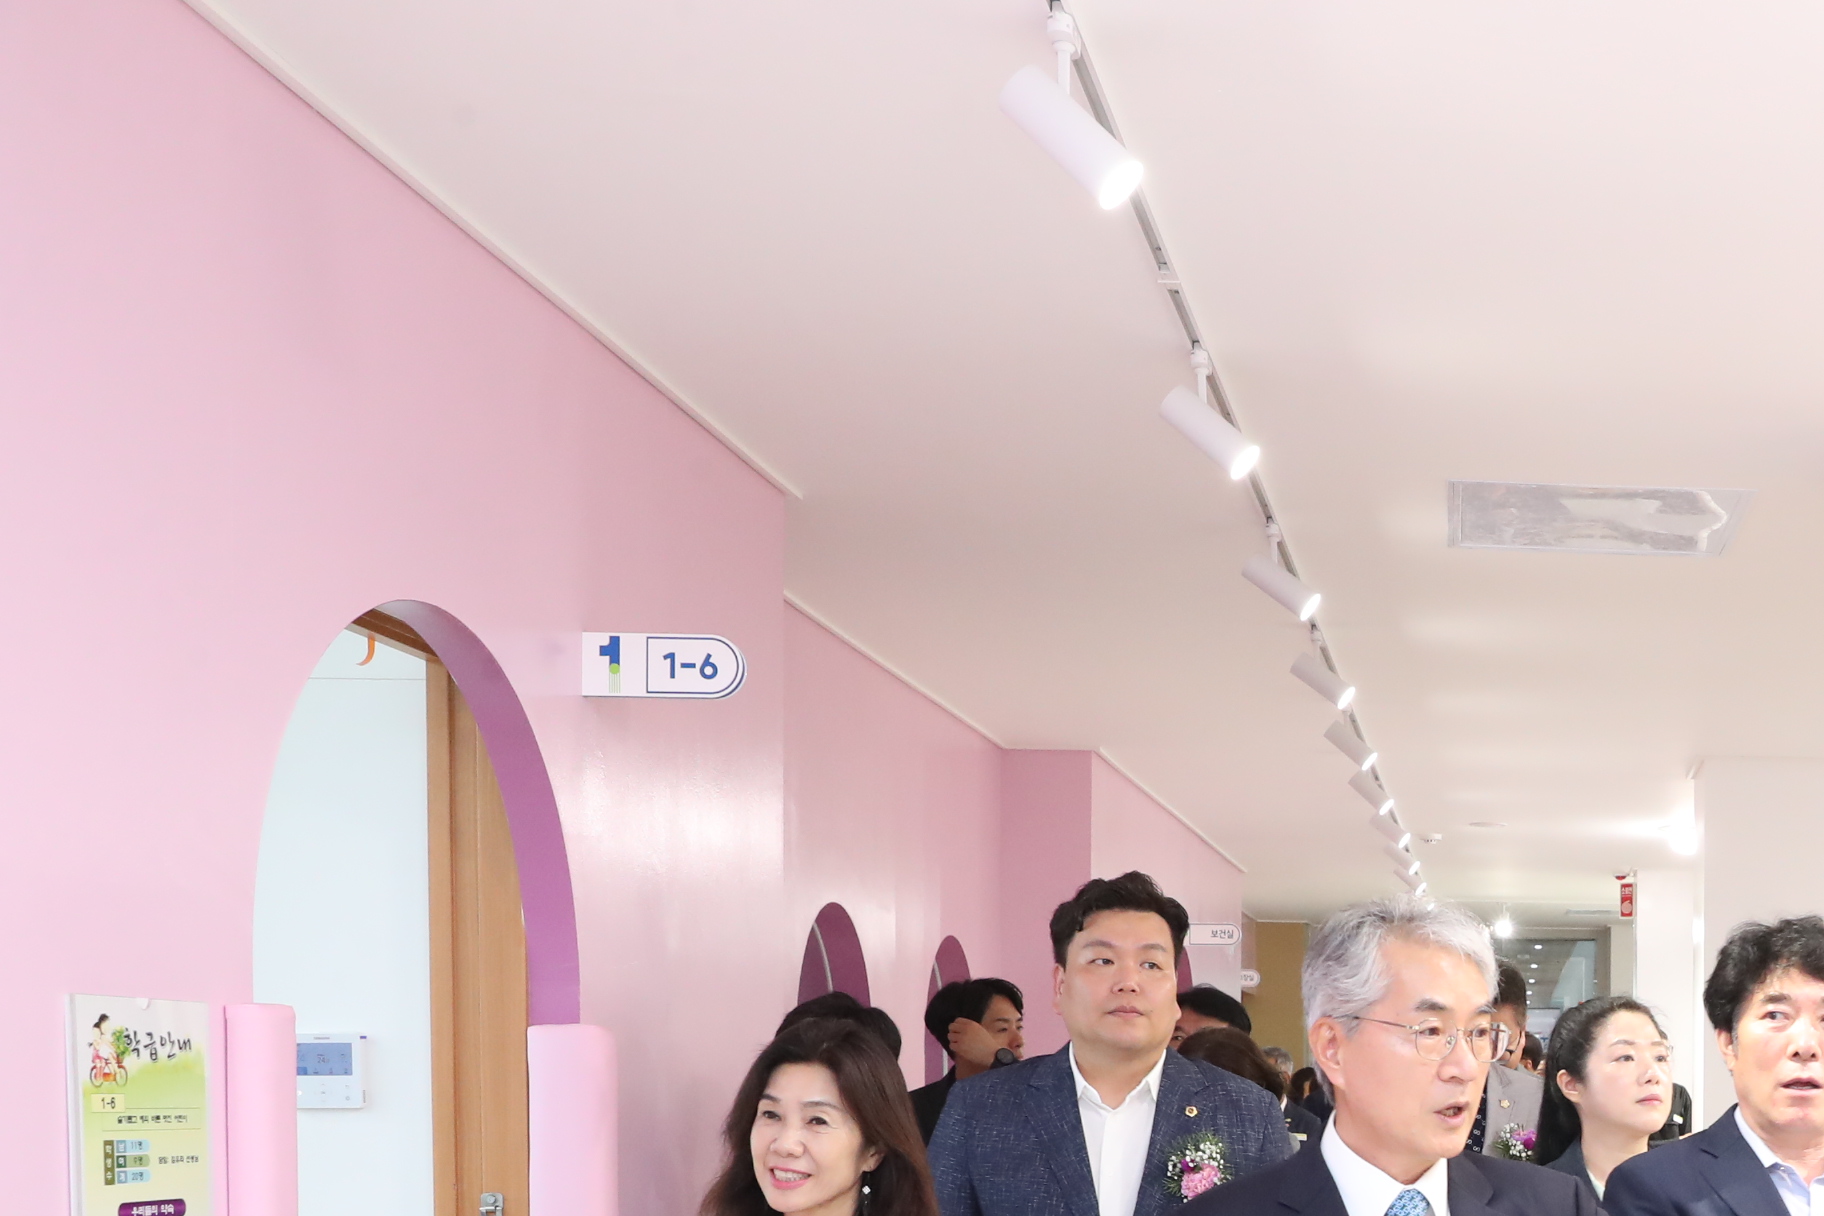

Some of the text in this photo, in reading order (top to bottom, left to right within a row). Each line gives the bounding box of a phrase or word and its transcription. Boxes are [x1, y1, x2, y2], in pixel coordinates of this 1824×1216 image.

[662, 652, 718, 680] 1-6
[1210, 929, 1234, 939] 보건실
[124, 1028, 192, 1061] 학급안내
[101, 1097, 116, 1110] 1-6
[151, 1114, 161, 1123] 바른
[131, 1141, 143, 1151] 11명
[186, 1155, 199, 1163] 선생님
[131, 1172, 144, 1181] 20명
[131, 1203, 175, 1216] 우리들의 약속
